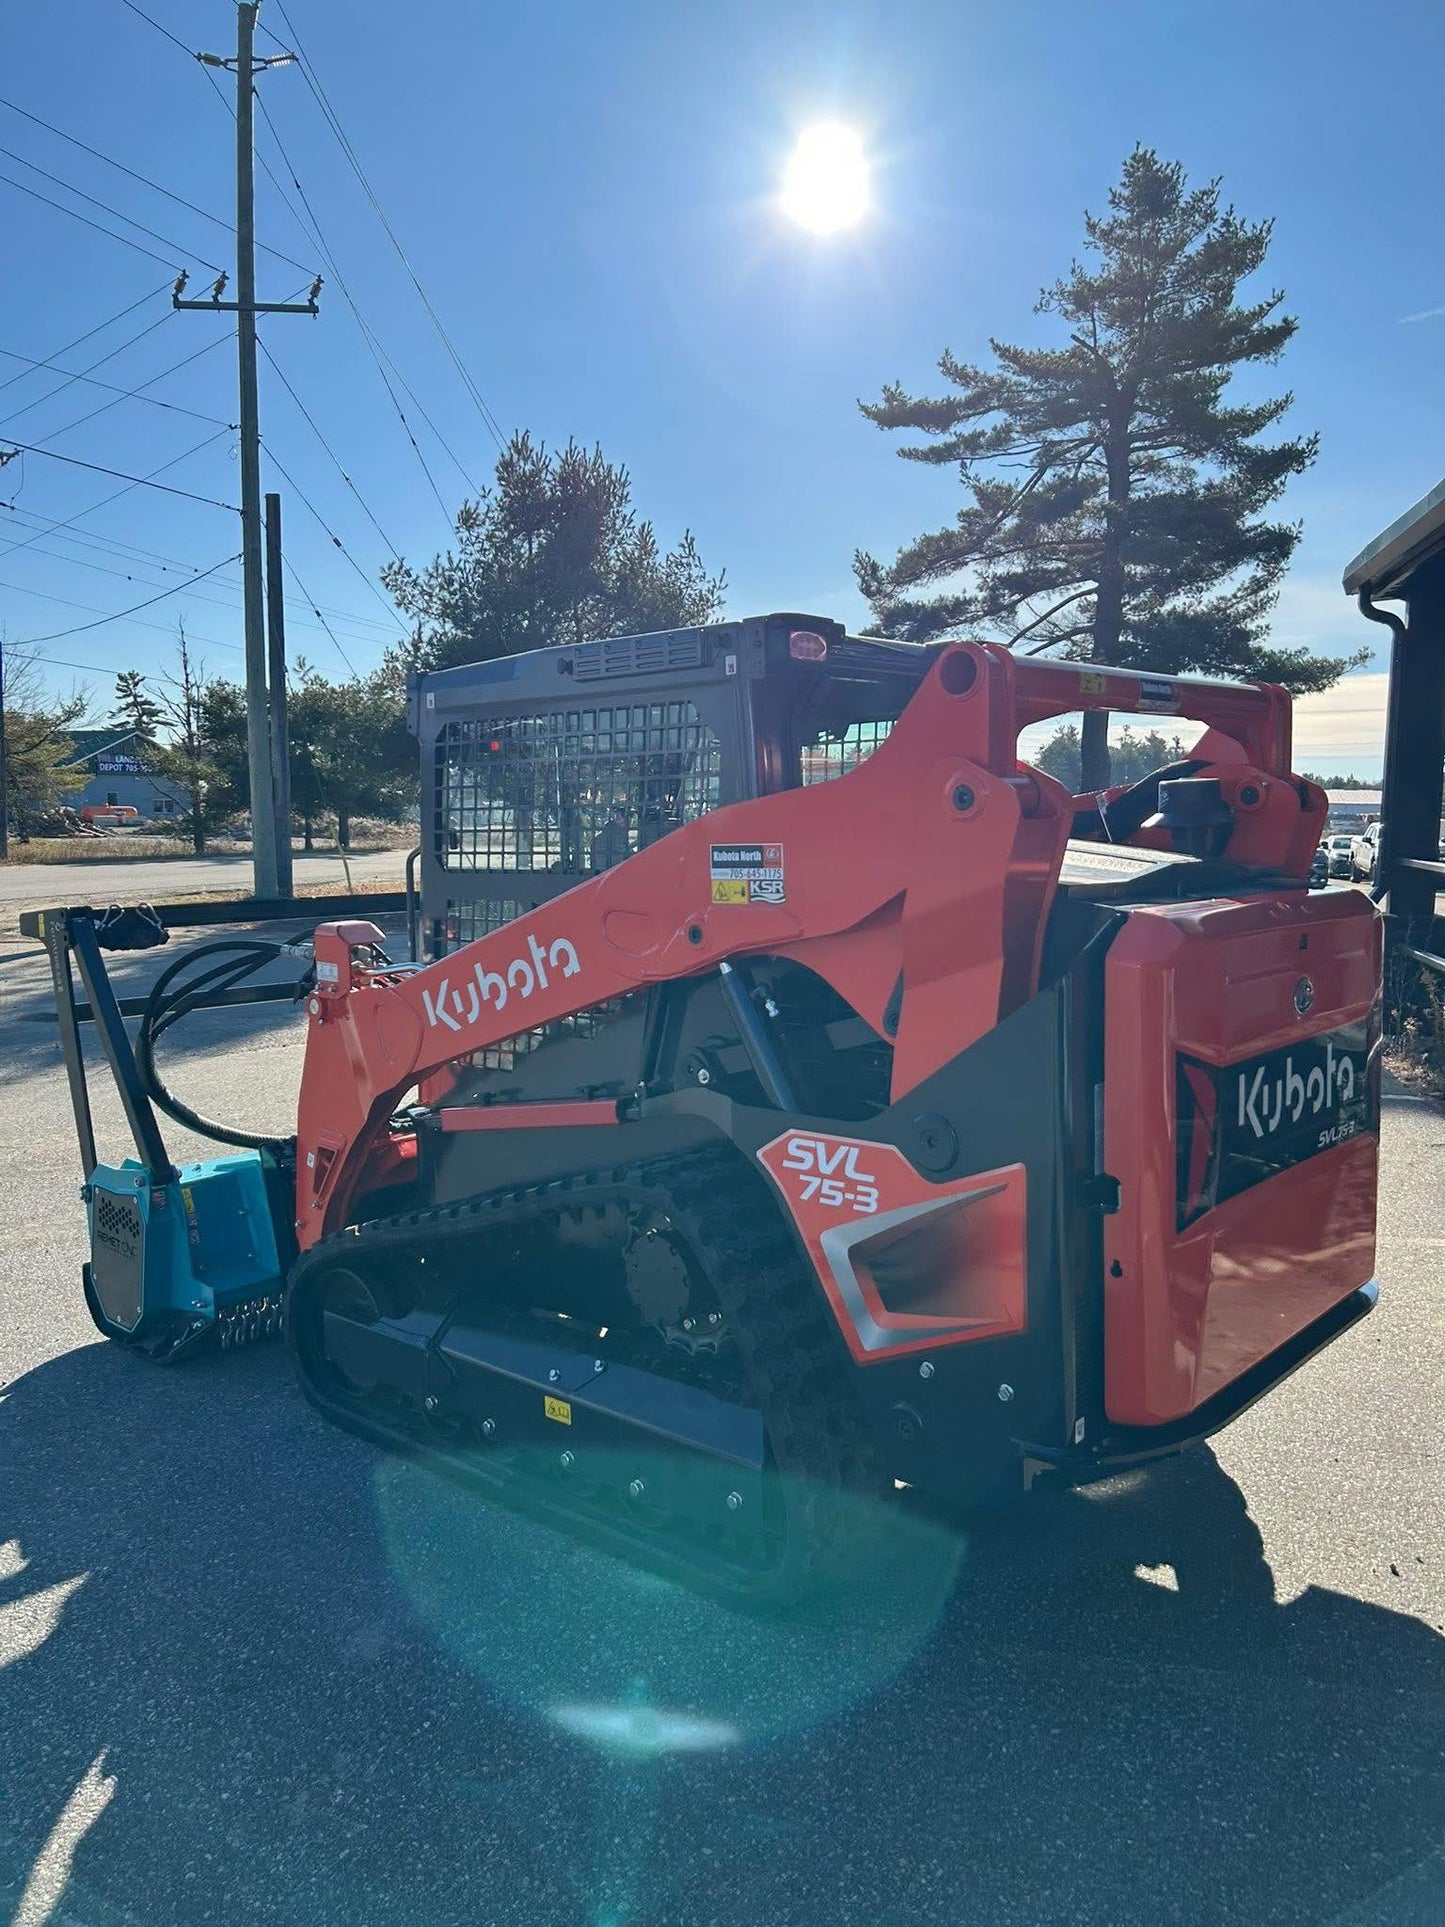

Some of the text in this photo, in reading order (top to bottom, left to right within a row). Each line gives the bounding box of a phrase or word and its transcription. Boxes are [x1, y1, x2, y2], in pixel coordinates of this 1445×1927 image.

[100, 763, 123, 772] DEPOT
[713, 850, 761, 861] Kubota North
[730, 868, 782, 879] 705-645-1175
[750, 880, 784, 894] KSR
[422, 934, 581, 1032] Kubota
[1238, 1042, 1354, 1138] Kubota
[782, 1137, 875, 1183] SVL
[799, 1173, 879, 1213] 75-3
